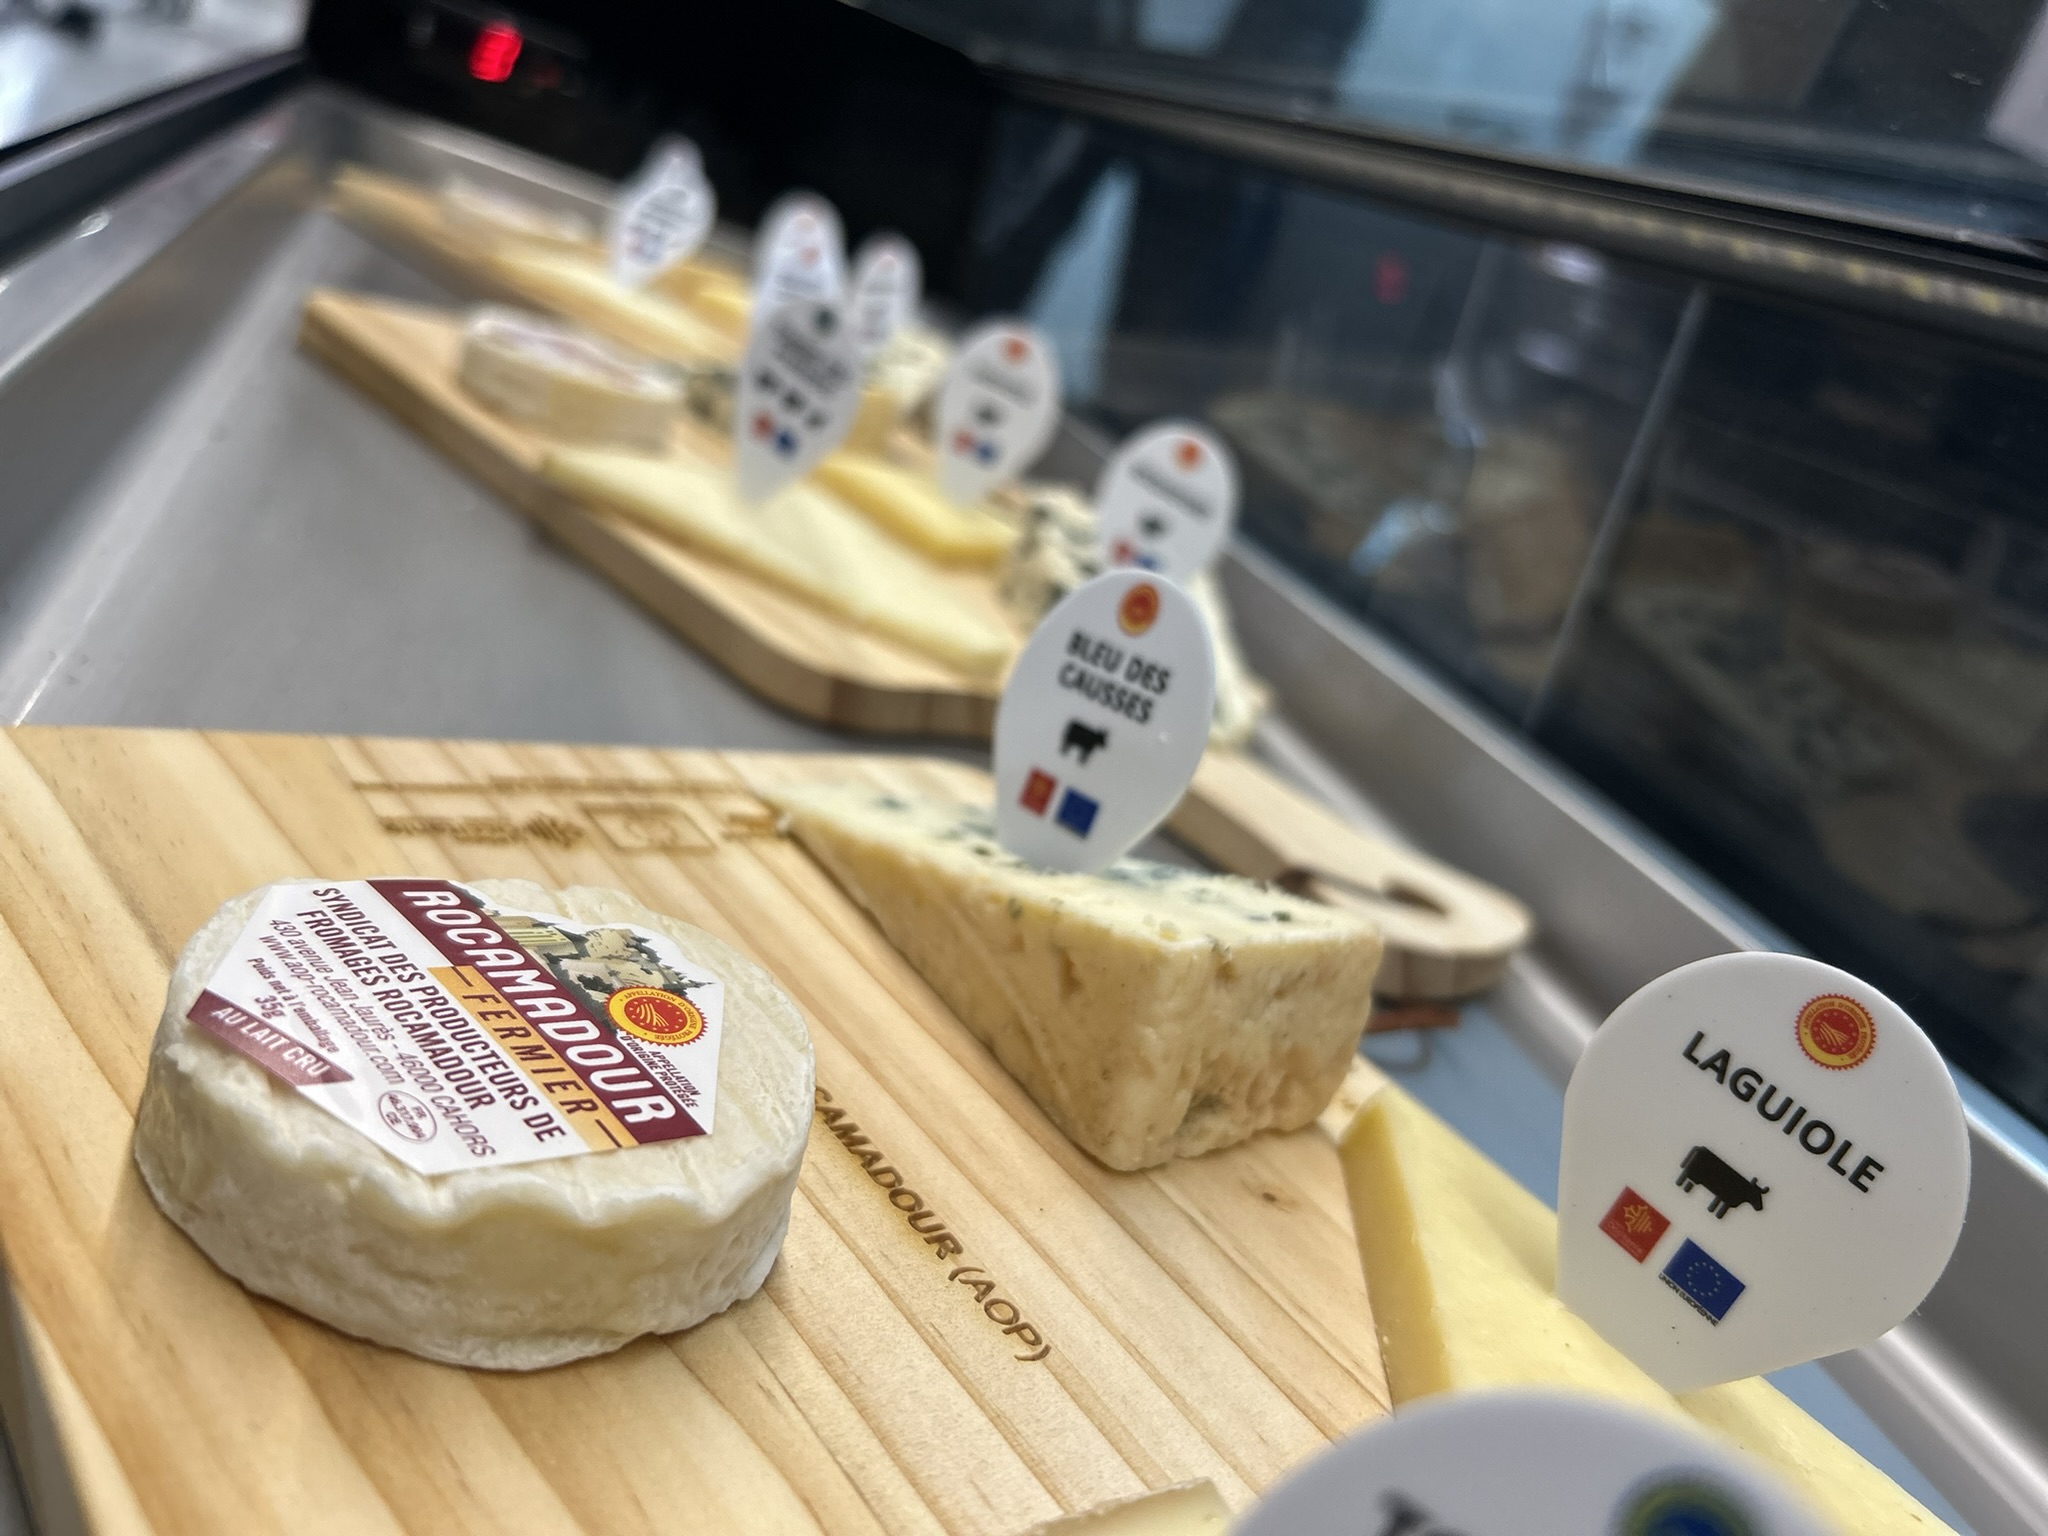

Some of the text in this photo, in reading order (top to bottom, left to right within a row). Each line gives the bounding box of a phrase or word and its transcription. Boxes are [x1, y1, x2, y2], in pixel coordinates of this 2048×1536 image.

[1058, 662, 1153, 724] CAUSSES
[1067, 631, 1170, 696] BLEU DES
[210, 1005, 331, 1077] AU LAIT CRU
[254, 994, 287, 1020] 35g
[269, 919, 303, 938] 430
[287, 939, 334, 974] avenue
[324, 975, 360, 1002] Jean
[349, 1003, 397, 1042] Jaurès
[398, 1052, 444, 1092] 46000
[431, 1095, 496, 1157] CAHORS
[296, 909, 496, 1111] FROMAGES ROCAMADOUR
[312, 887, 567, 1143] SYNDICAT DES PRODUCTEURS DE
[402, 890, 677, 1124] ROCAMADOUR
[462, 993, 599, 1115] FERMIER
[1682, 1030, 1885, 1194] LAGUIOLE
[948, 1265, 1052, 1362] (AOP)
